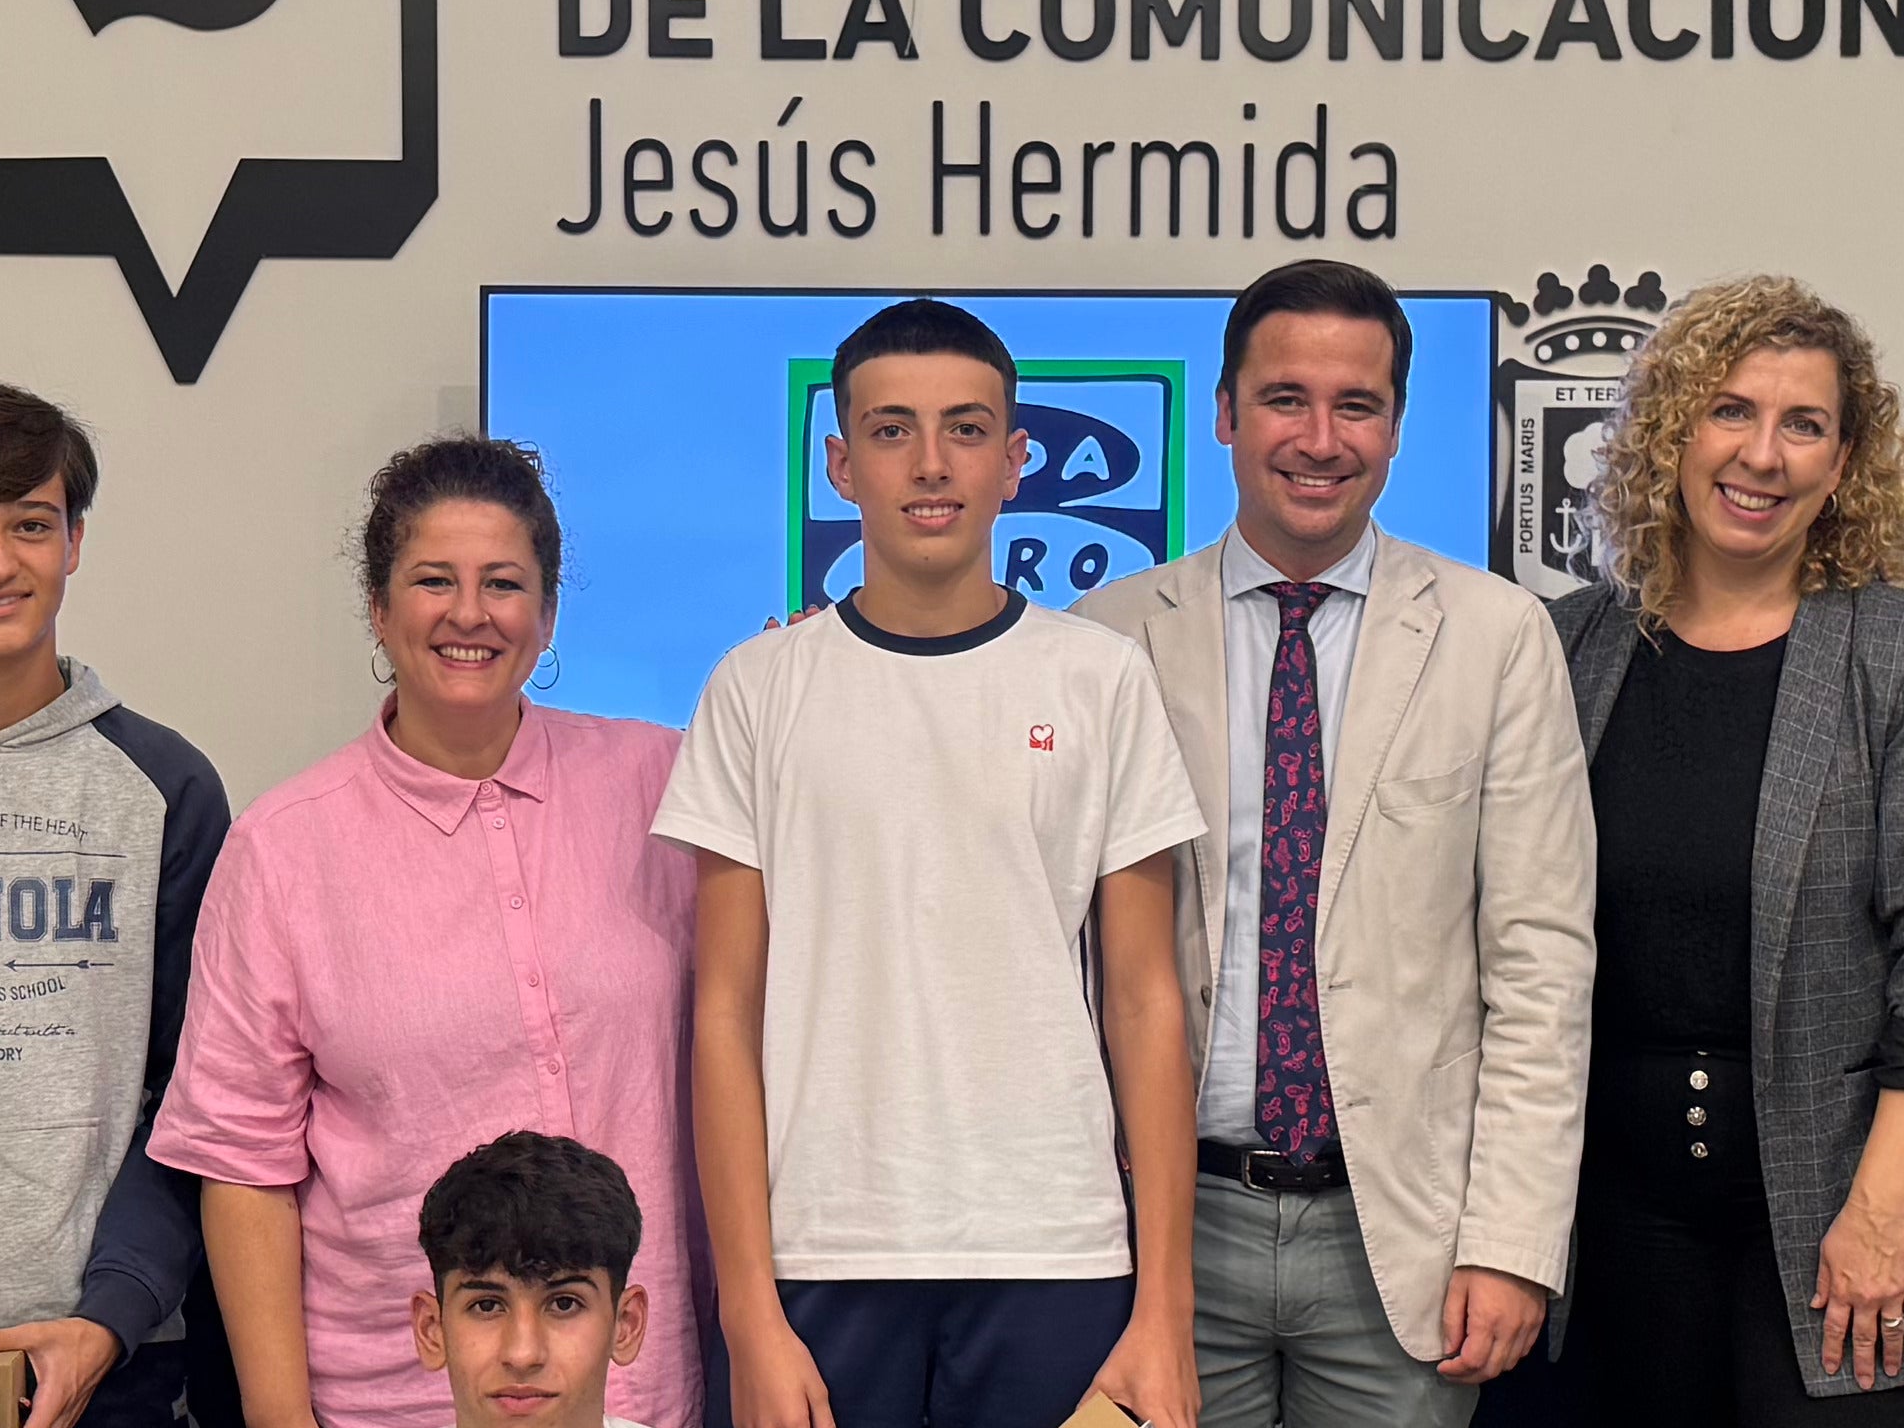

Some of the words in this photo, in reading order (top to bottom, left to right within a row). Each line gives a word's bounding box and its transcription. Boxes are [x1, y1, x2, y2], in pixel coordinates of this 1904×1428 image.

[556, 97, 878, 238] Jesús
[931, 100, 1399, 240] Hermida
[1555, 387, 1576, 402] ET
[1521, 418, 1535, 473] MARIS
[1520, 483, 1534, 554] PORTUS
[1005, 537, 1109, 592] RO
[12, 814, 43, 832] THE
[46, 818, 88, 844] HEAT
[10, 975, 66, 1001] SCHOOL
